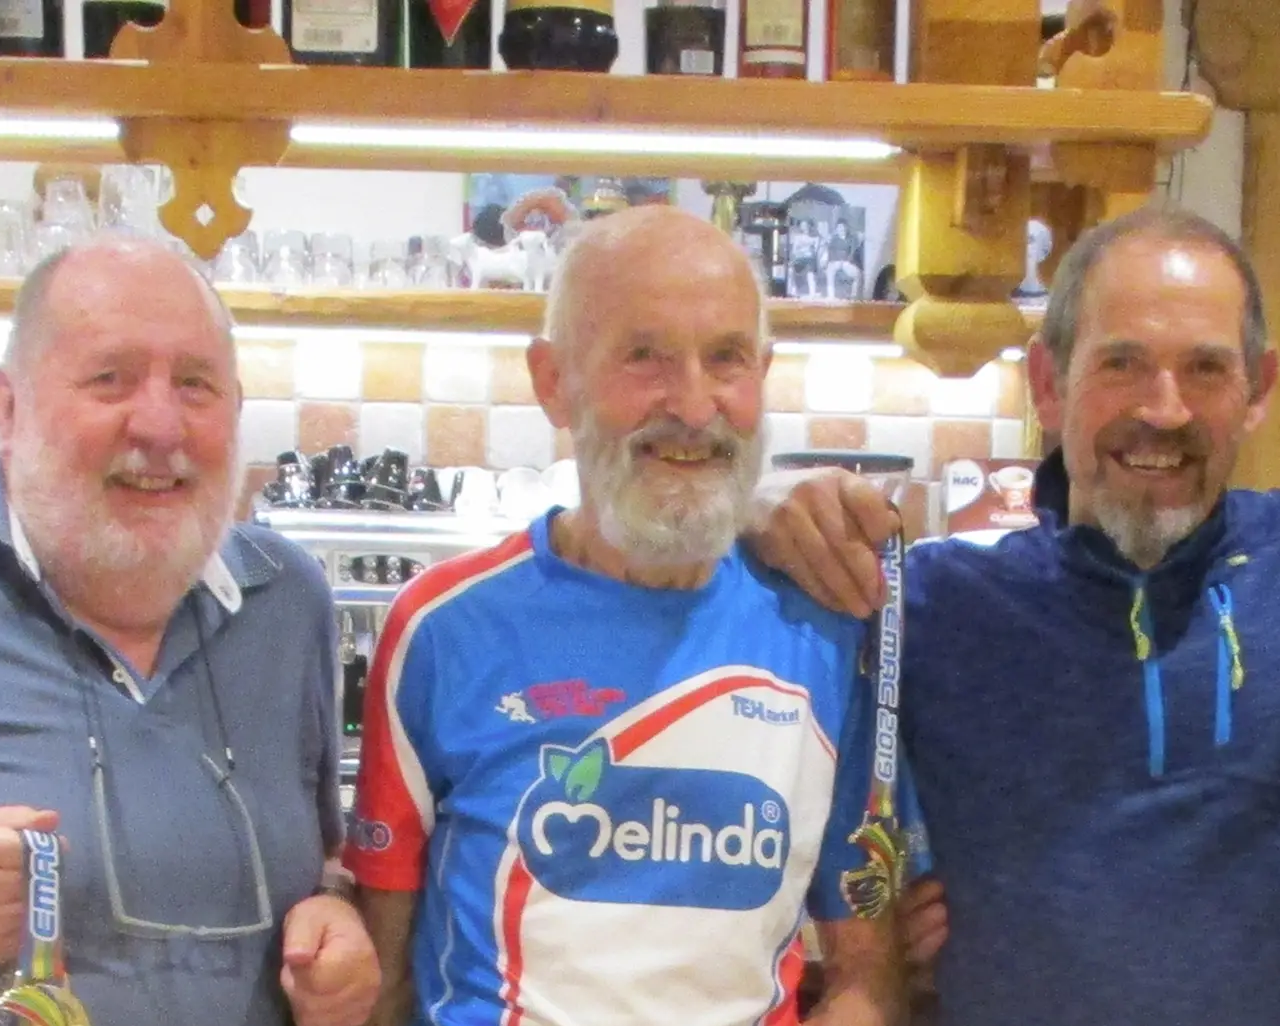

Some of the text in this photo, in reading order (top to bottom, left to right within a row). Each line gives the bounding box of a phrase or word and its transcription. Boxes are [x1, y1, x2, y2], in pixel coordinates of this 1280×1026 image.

[877, 603, 902, 708] EMAC
[874, 707, 898, 784] 2019
[531, 797, 784, 869] Melinda
[24, 828, 62, 942] EMAC
